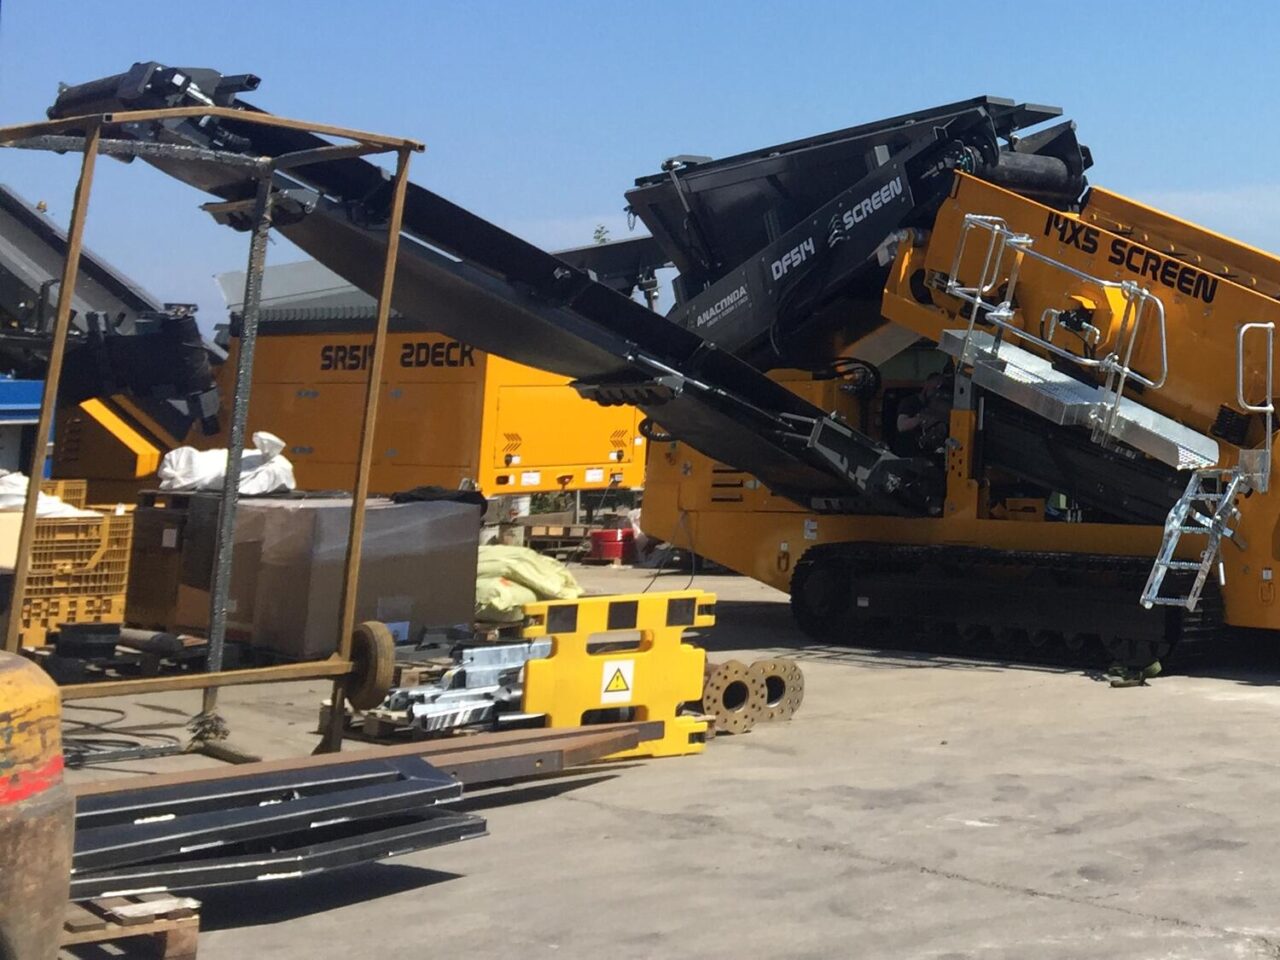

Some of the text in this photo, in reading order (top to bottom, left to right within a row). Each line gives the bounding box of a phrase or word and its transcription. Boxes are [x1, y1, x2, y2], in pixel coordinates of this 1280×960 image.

[842, 176, 903, 230] SCREEN
[771, 237, 816, 280] DF514
[1044, 212, 1218, 304] 14X5 SCREEN
[697, 286, 747, 327] ANACONDA
[400, 342, 475, 368] 2DECK
